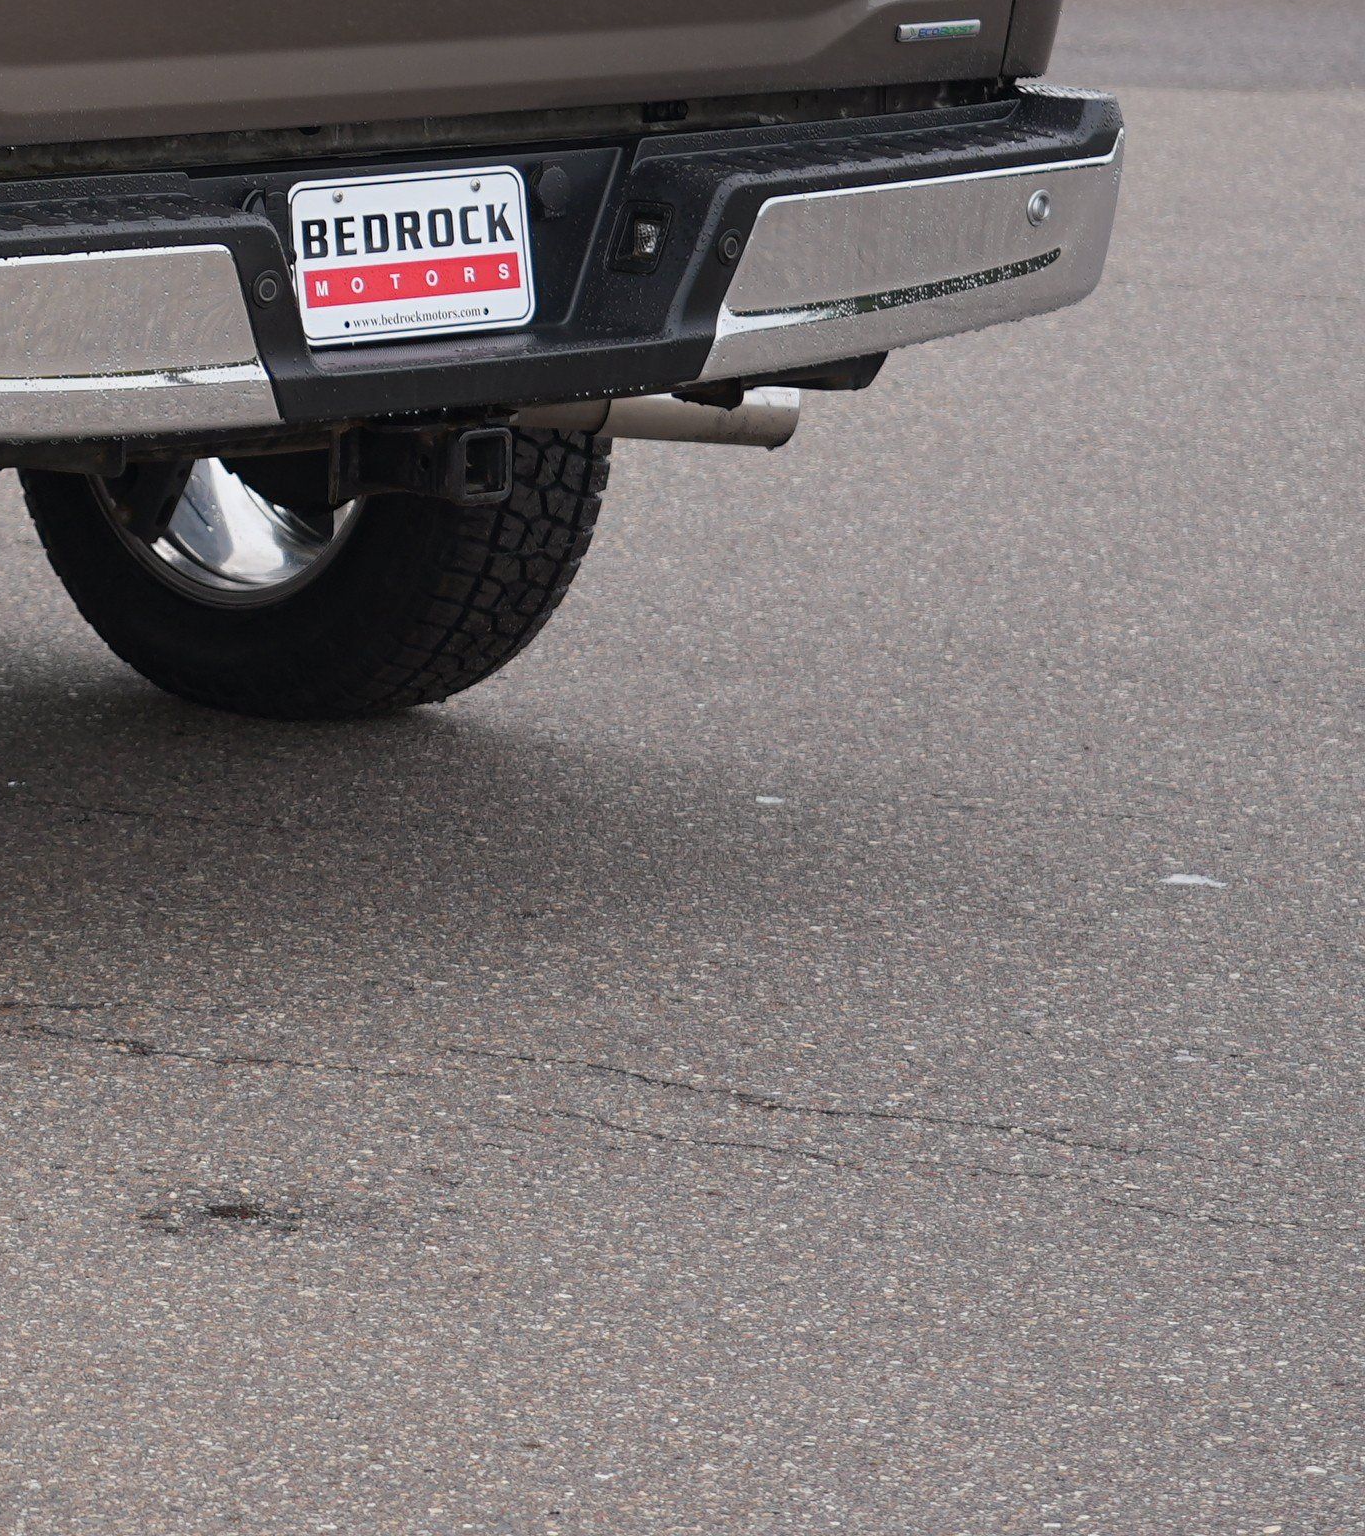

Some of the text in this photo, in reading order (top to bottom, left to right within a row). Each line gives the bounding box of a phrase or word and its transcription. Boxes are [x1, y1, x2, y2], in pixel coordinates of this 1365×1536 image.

[301, 202, 515, 260] BEDROCK
[315, 263, 510, 297] MOTORS
[352, 307, 481, 329] www.bedrockmotors.com
